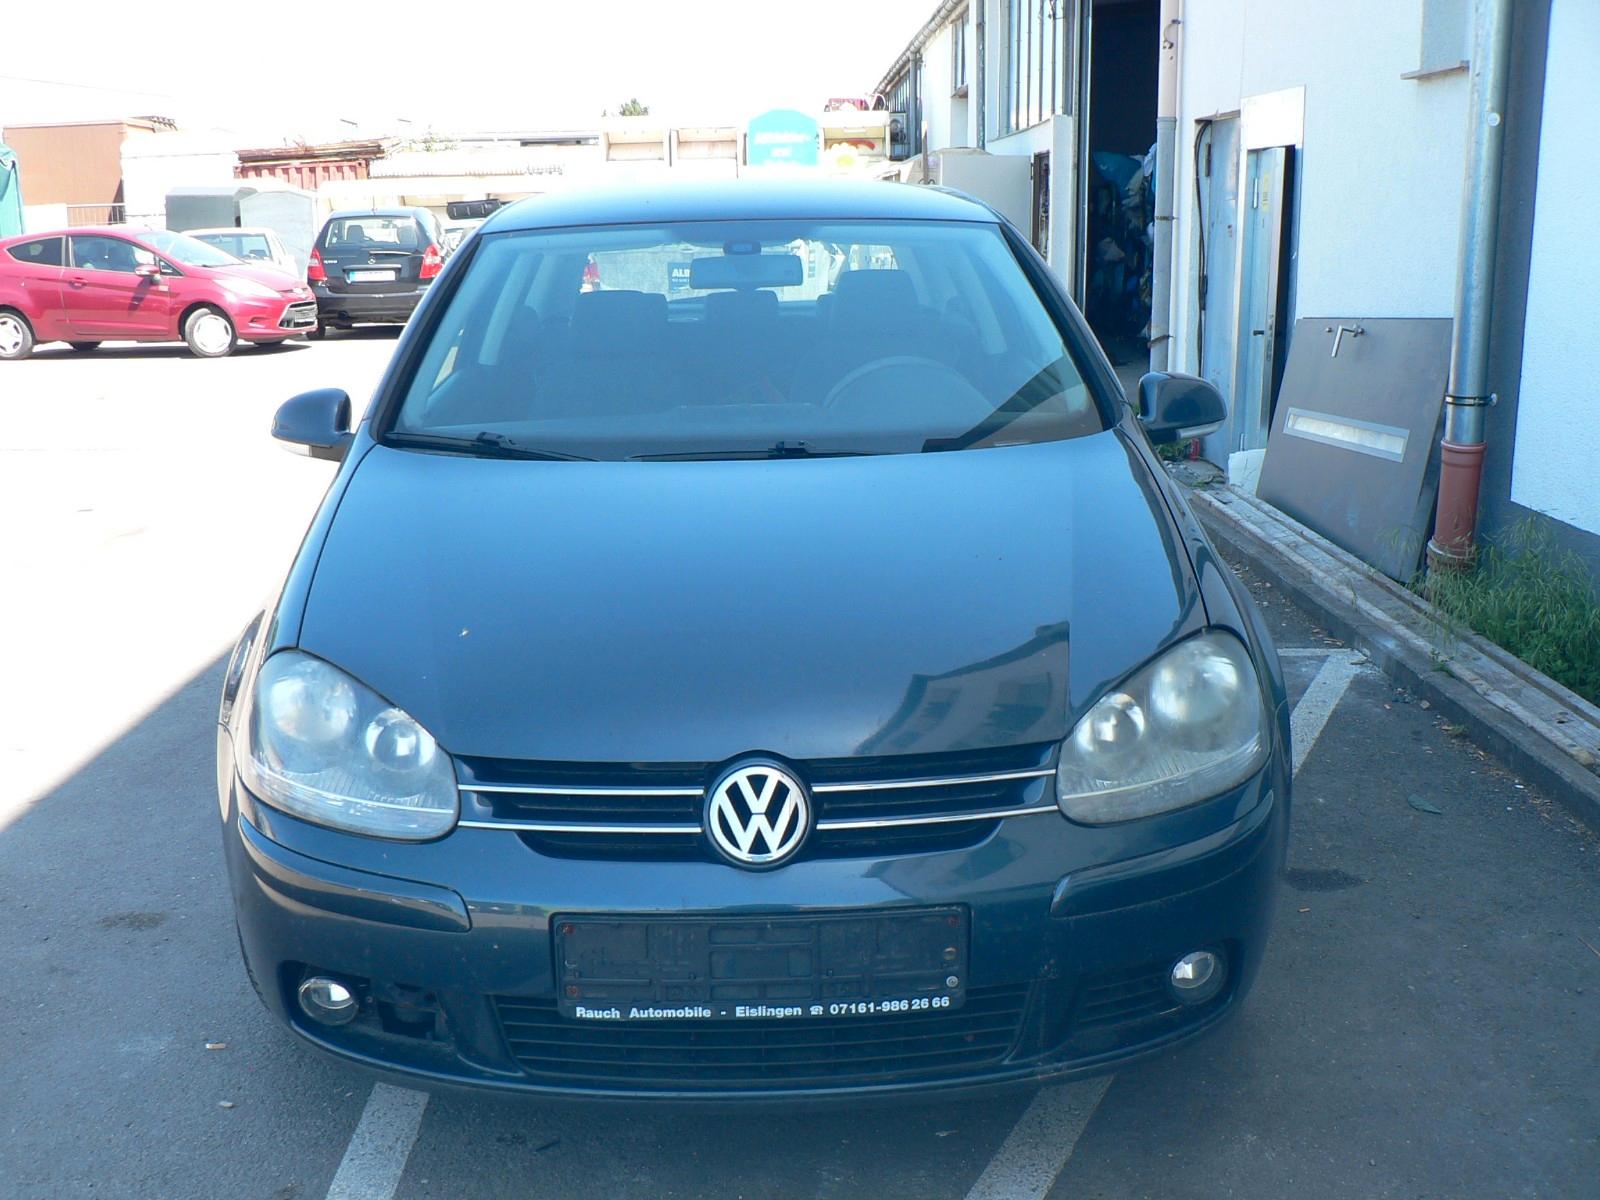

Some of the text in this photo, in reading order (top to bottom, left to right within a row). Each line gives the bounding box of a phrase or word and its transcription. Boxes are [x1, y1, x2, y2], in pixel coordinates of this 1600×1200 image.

[709, 765, 809, 862] VW
[575, 1006, 620, 1019] Rauch
[629, 1006, 712, 1019] Automobile
[735, 1005, 802, 1018] Eislingen
[829, 999, 909, 1015] 07161-986
[911, 997, 929, 1010] 26
[932, 996, 950, 1008] 66
